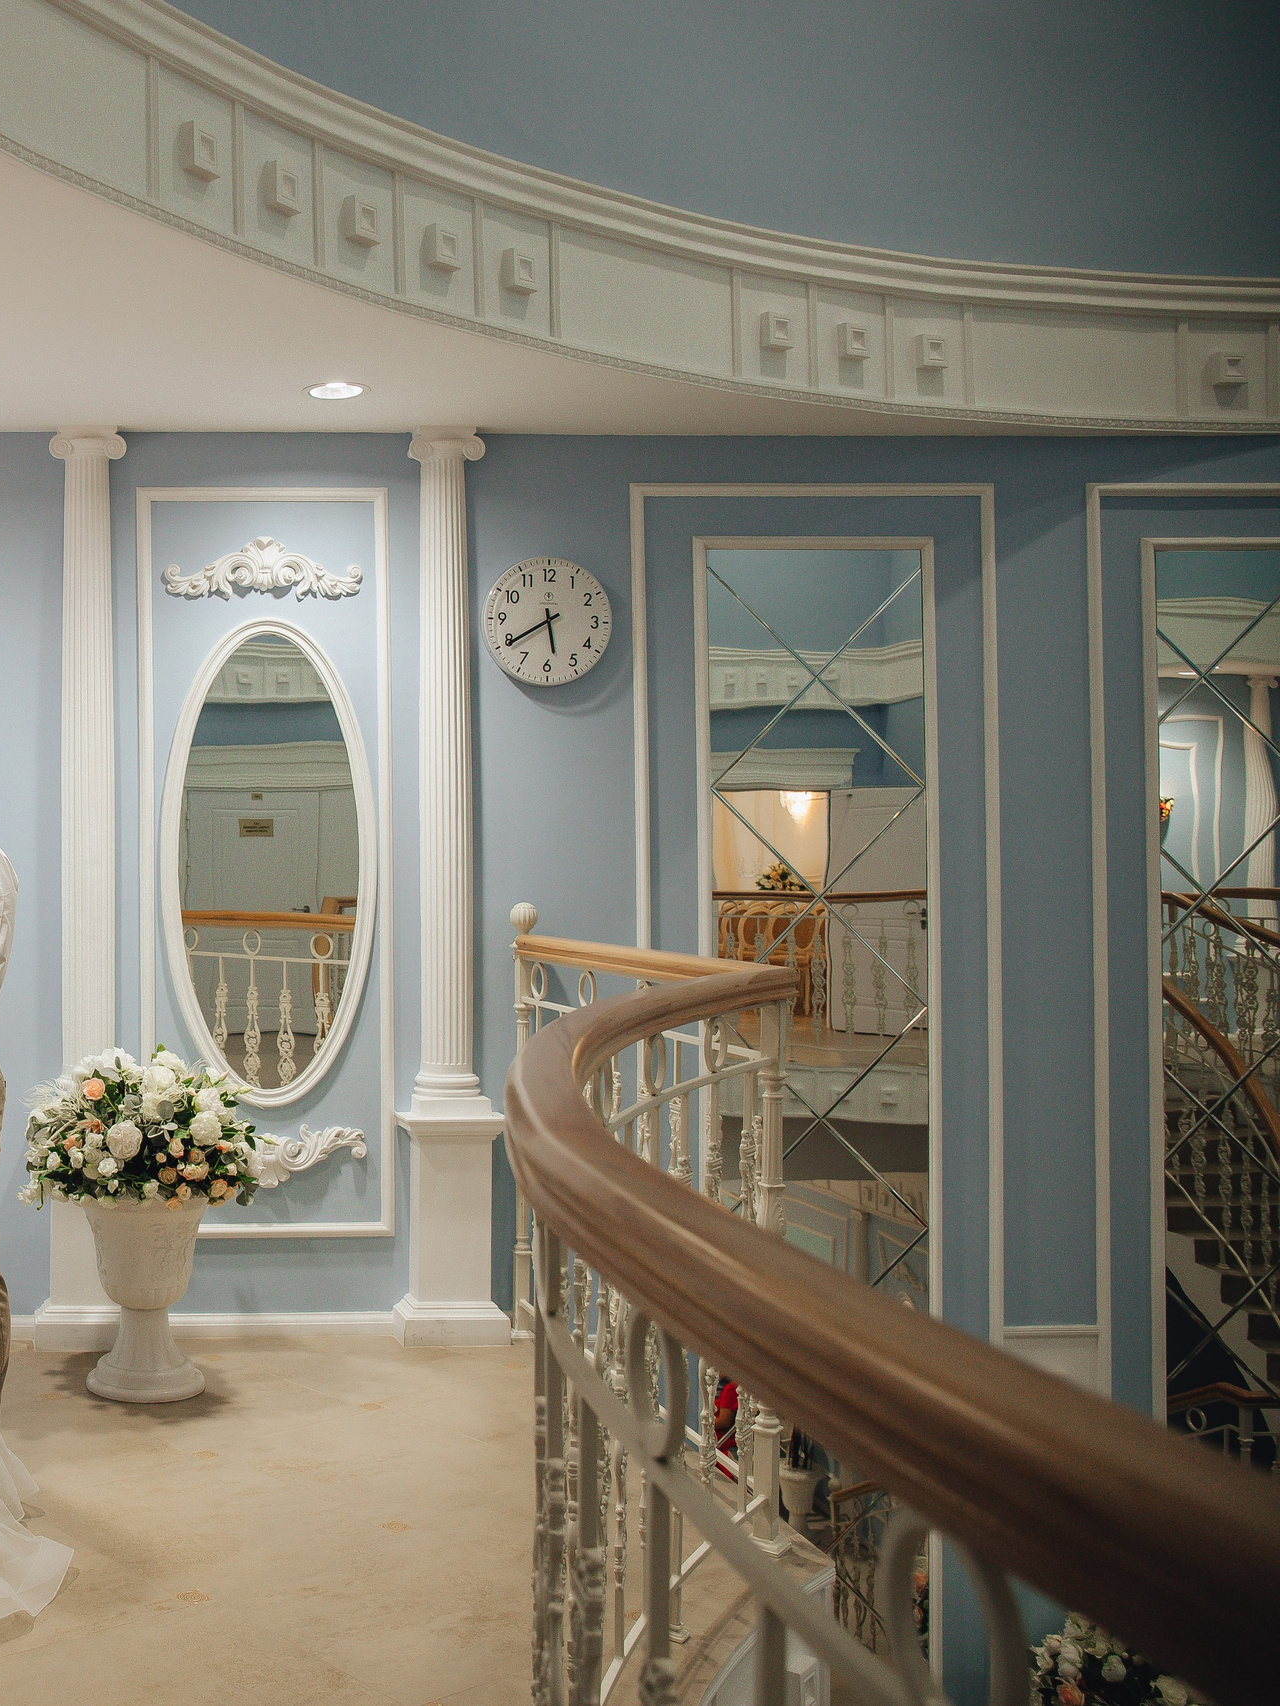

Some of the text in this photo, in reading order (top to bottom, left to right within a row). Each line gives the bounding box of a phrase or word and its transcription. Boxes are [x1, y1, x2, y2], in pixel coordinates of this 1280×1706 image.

[522, 574, 533, 587] 11
[542, 569, 556, 582] 12
[570, 576, 574, 589] 1
[506, 590, 520, 603] 10
[583, 593, 592, 606] 2
[498, 612, 507, 625] 9
[590, 615, 599, 629] 3
[505, 633, 513, 647] 8
[582, 636, 592, 649] 4
[520, 652, 529, 664] 7
[569, 654, 578, 667] 5
[542, 659, 552, 672] 6
